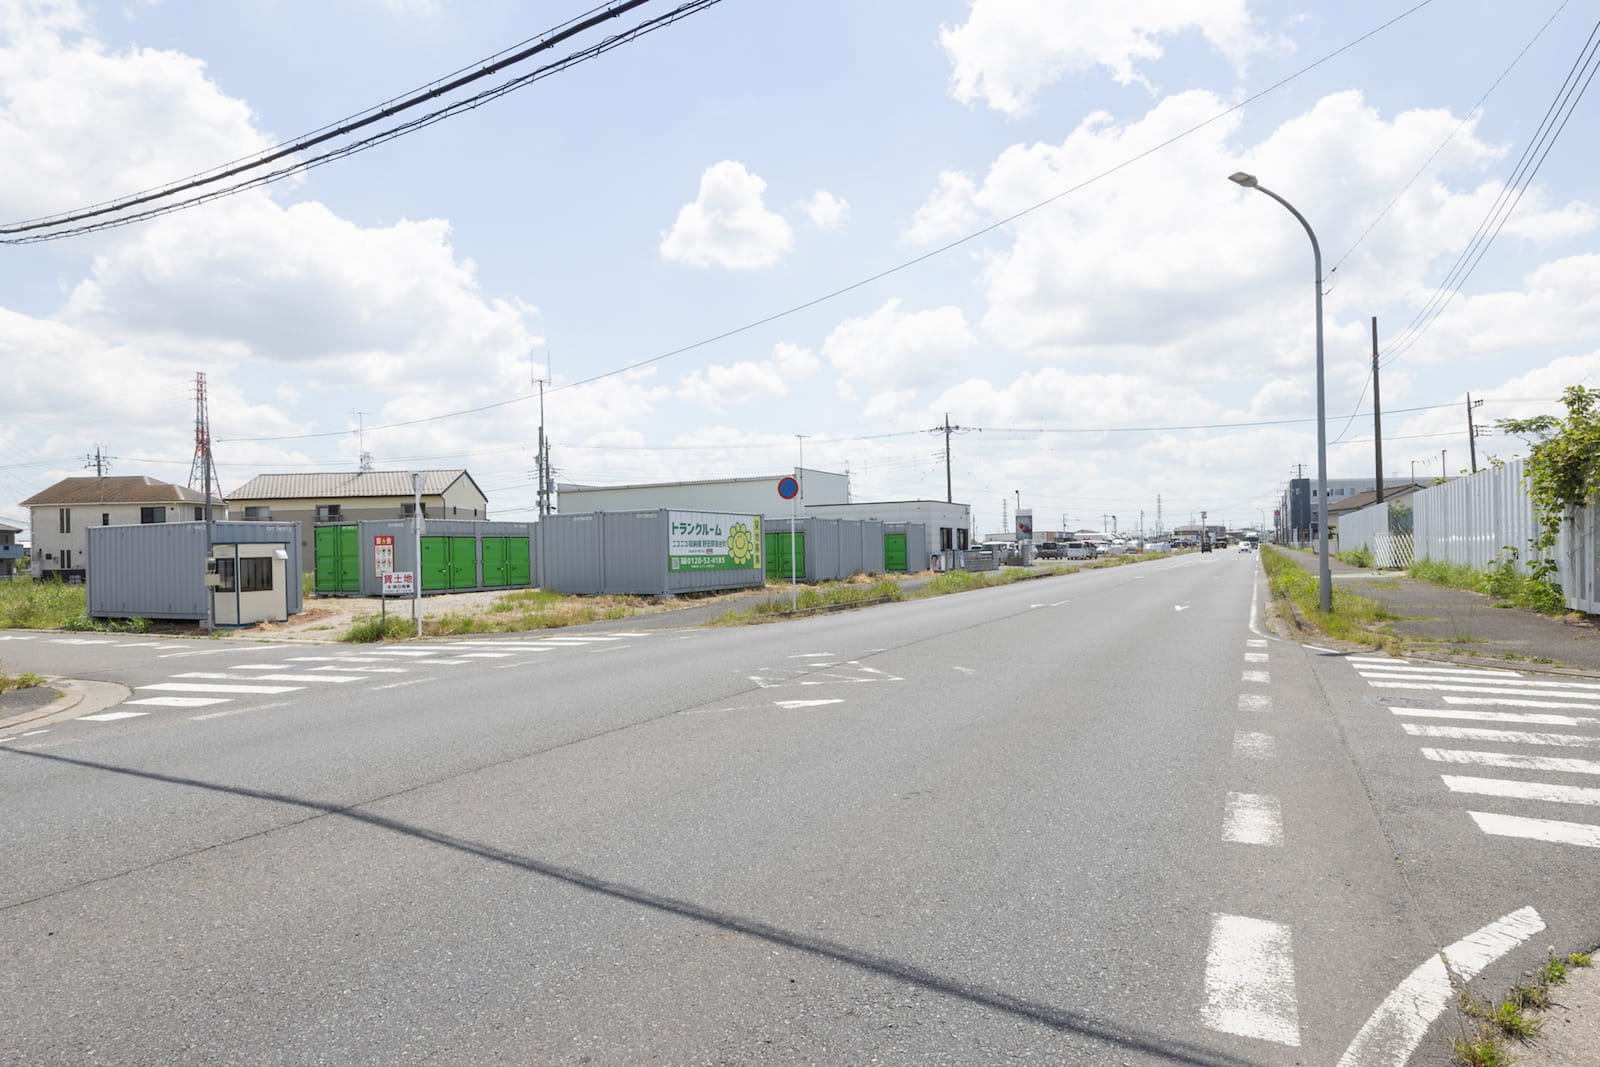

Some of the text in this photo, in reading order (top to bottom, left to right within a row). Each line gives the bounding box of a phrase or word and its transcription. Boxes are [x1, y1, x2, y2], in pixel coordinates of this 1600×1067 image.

[672, 522, 721, 536] トランクルーム
[384, 574, 412, 584] 貸土地
